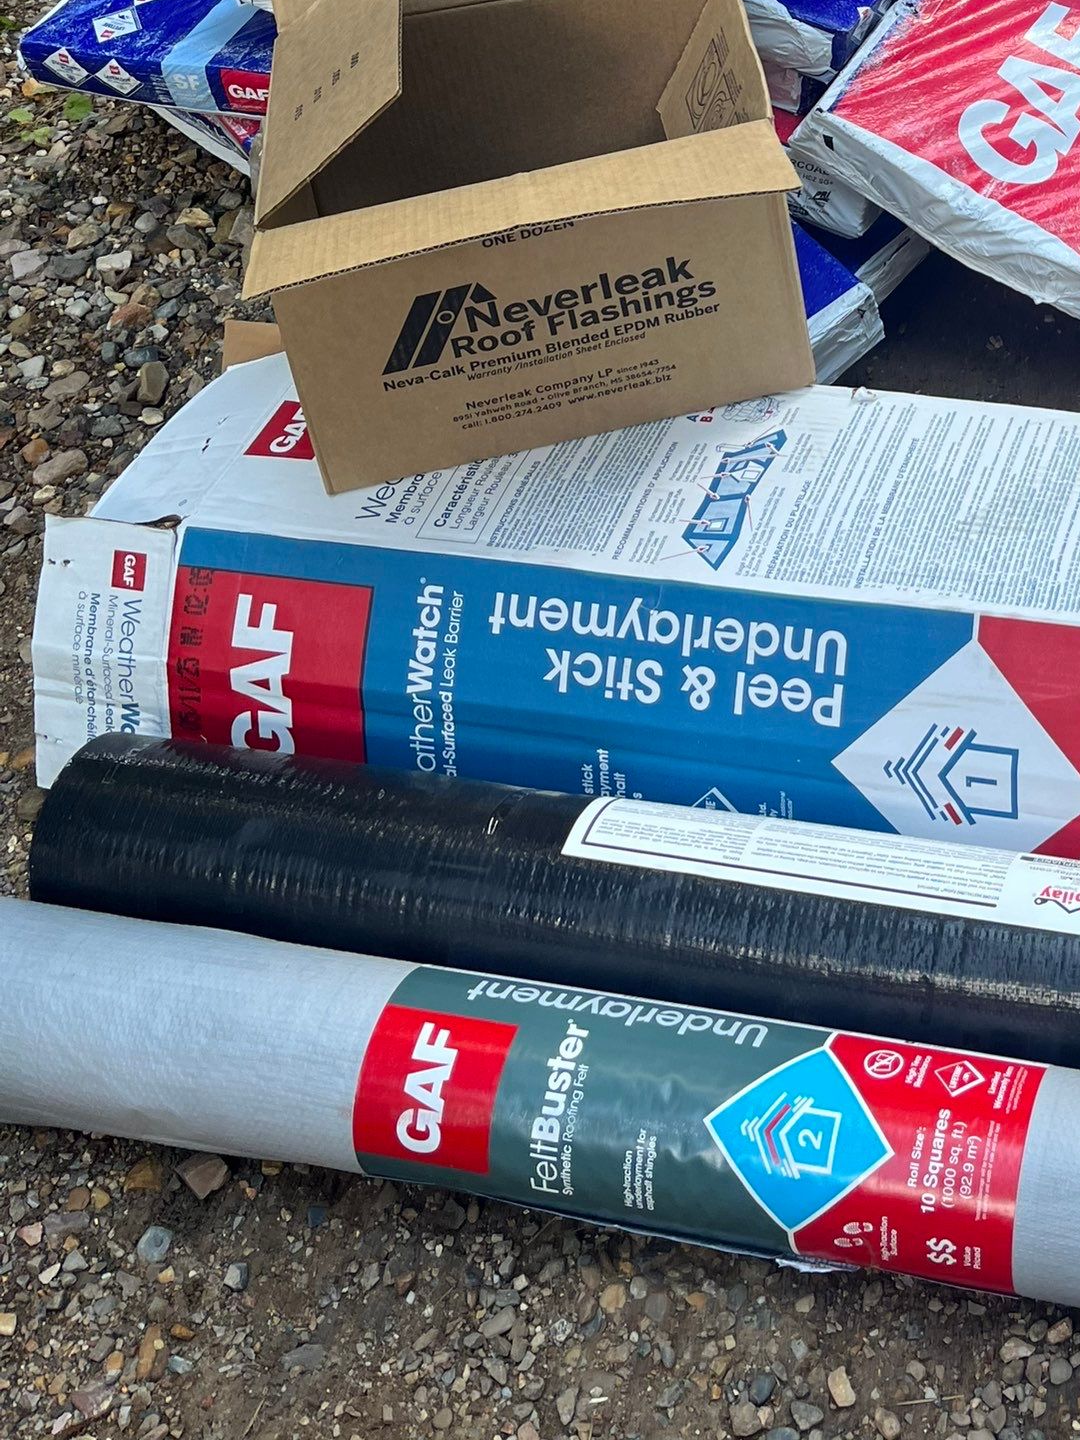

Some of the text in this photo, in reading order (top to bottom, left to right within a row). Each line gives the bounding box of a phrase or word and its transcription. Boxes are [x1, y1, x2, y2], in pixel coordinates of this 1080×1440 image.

[173, 73, 199, 90] SF
[482, 231, 516, 248] ONE
[452, 280, 716, 358] Roof Flashings
[465, 256, 695, 333] Neverleak
[383, 302, 720, 392] Neva-Calk Premium Blended EPDM Rubber
[467, 365, 512, 382] Warranty
[576, 342, 602, 356] Sheet
[604, 331, 646, 349] Enclosed
[453, 412, 473, 423] 8951
[475, 402, 512, 418] Yahweh
[514, 397, 538, 409] Road
[547, 389, 571, 401] Olive
[573, 379, 609, 395] Branch,
[462, 374, 672, 430] call: 1.800.274.2409 www.neverleak.biz
[466, 364, 638, 411] Neverleak Company LP since
[413, 471, 443, 517] surface
[123, 553, 137, 588] GAF
[73, 600, 84, 646] surface
[85, 592, 101, 668] Membrane
[103, 594, 119, 700] Mineral-Surfaced
[442, 591, 464, 687] Leak Barrier
[489, 591, 849, 678] Underlayment
[231, 593, 295, 754] GAF
[542, 647, 844, 728] Peel & Stick
[581, 763, 593, 795] stick
[467, 980, 769, 1048] Underlayment
[396, 1021, 459, 1154] GAF
[562, 1063, 590, 1196] Synthetic Roofing Felt
[921, 1109, 951, 1214] 10 Squares
[635, 1146, 645, 1210] underlayment
[646, 1135, 657, 1211] asphalt shingles
[907, 1165, 918, 1189] Roll
[941, 1167, 955, 1208] (1000
[959, 1163, 974, 1200] (92.9
[925, 1237, 957, 1266] $$
